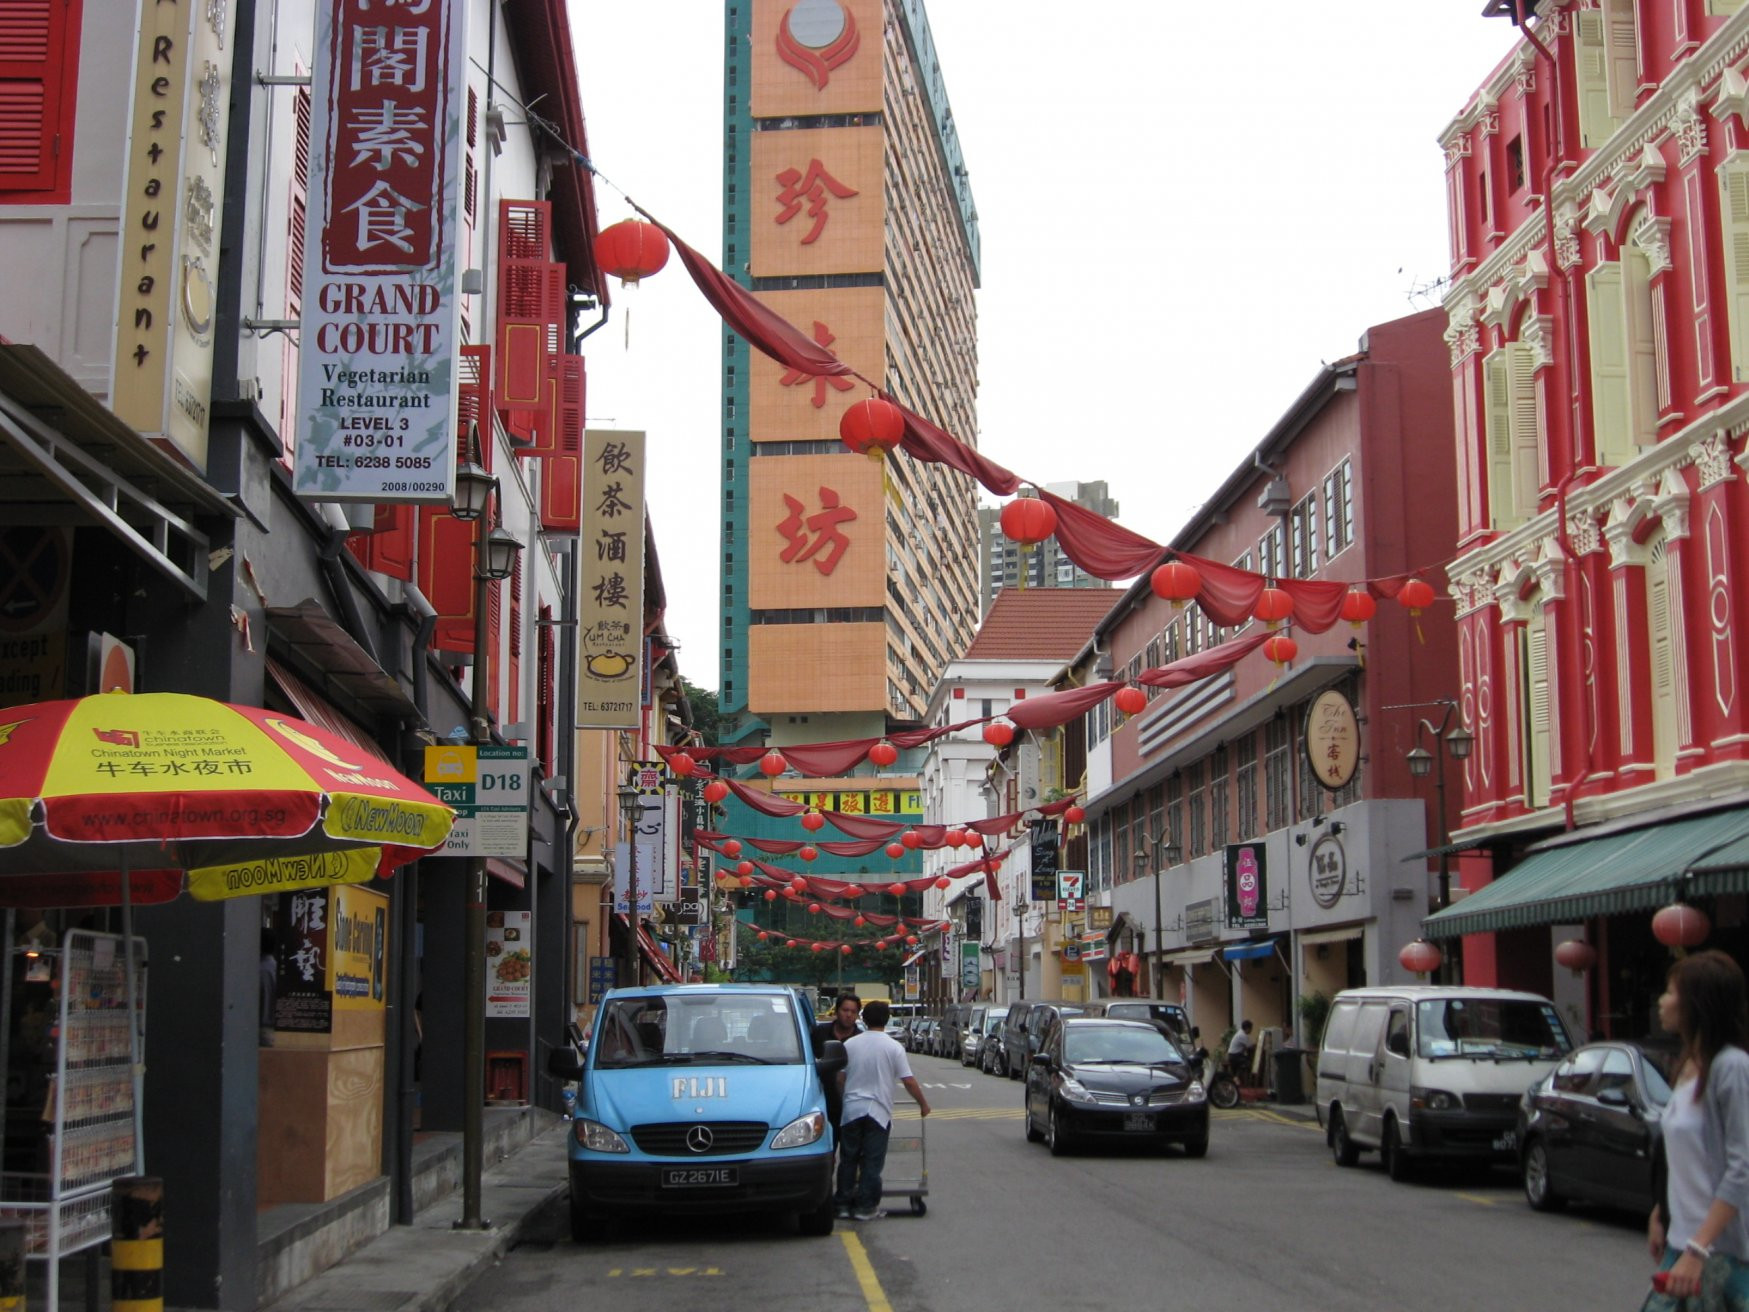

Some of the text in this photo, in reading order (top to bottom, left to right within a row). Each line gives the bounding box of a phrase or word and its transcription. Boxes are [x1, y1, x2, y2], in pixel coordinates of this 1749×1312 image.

[341, 0, 432, 253] 閣素食
[133, 36, 173, 367] Restaurant
[319, 282, 441, 315] GRAND
[316, 322, 440, 355] COURT
[321, 363, 431, 389] Vegetarian
[319, 387, 431, 408] Restaurant
[340, 417, 409, 431] LEVEL 3
[343, 434, 404, 448] #03-01
[315, 455, 431, 469] TEL: 6238 5085
[381, 482, 446, 492] 2008/00290
[592, 441, 634, 609] 飲茶酒樓
[583, 701, 633, 713] TEL: 63721717
[1320, 703, 1346, 718] The
[144, 735, 226, 743] chinatown
[91, 746, 247, 759] Chinatown Night Market
[95, 759, 253, 777] 牛车水夜市
[481, 773, 522, 791] D18
[434, 786, 467, 801] Taxi
[83, 807, 287, 827] www.chinatown.org.sg
[448, 829, 469, 838] Taxi
[447, 840, 469, 850] Only
[671, 1076, 728, 1098] FIJI
[670, 1170, 731, 1184] GZ2671E
[607, 1267, 727, 1277] TAXI
